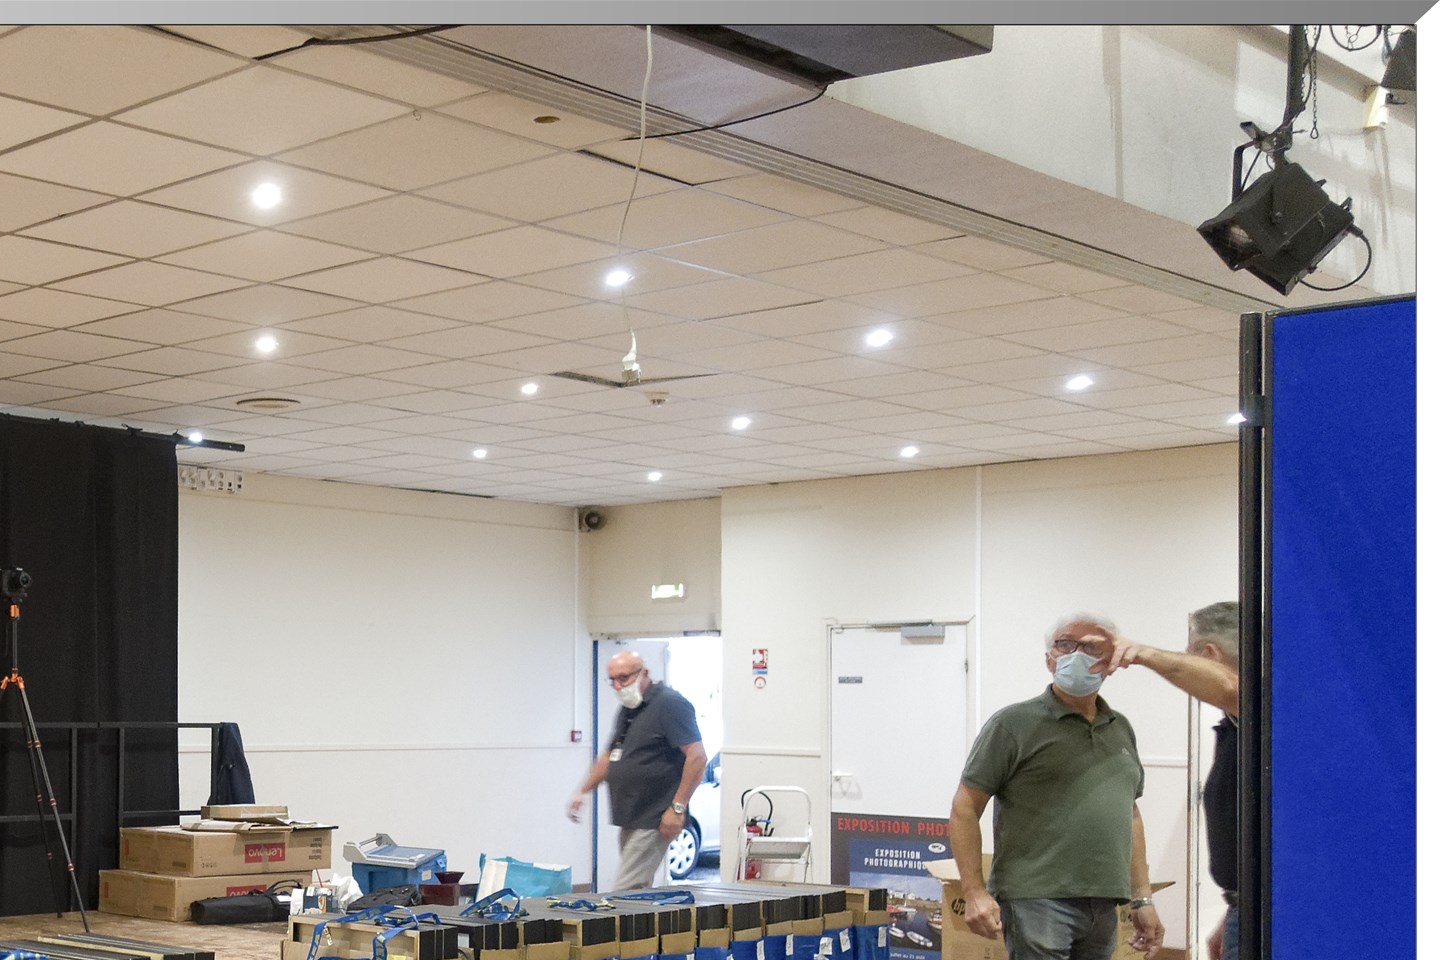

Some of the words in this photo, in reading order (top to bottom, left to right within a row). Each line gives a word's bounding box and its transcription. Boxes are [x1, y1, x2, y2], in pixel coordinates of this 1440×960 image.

[837, 817, 910, 834] EXPOSITION
[917, 823, 951, 836] PHOT
[248, 847, 282, 857] Lenovo
[875, 848, 921, 860] EXPOSITION
[864, 858, 926, 870] PHOTOGRAPHIQ
[952, 898, 966, 915] hp
